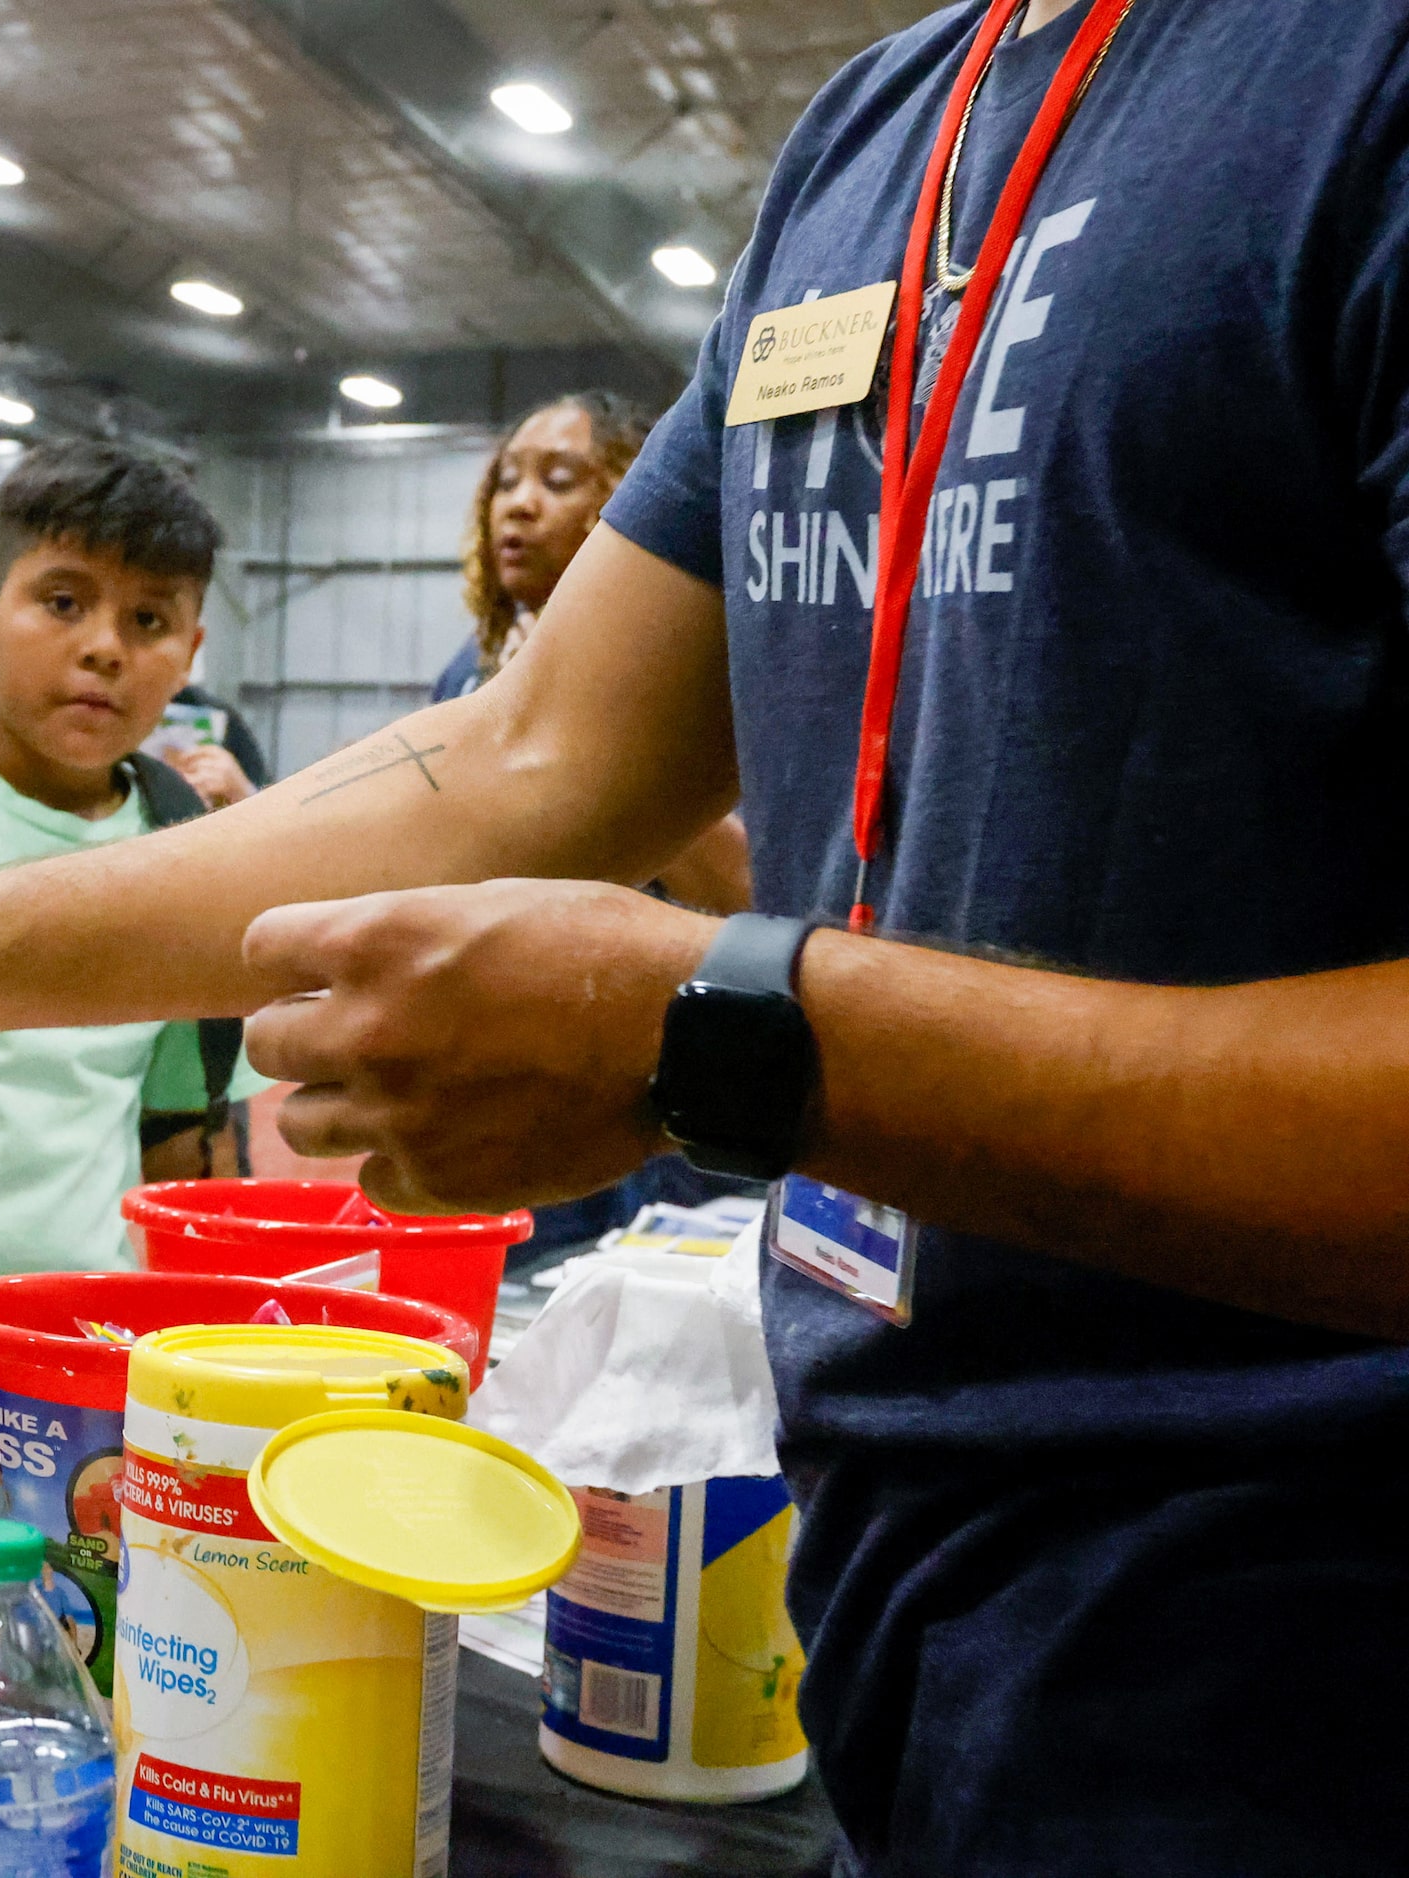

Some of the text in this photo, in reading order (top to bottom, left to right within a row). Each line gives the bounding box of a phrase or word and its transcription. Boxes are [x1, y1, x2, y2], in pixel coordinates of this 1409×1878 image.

[779, 310, 877, 352] BUCKNER
[756, 372, 846, 401] Neako Ramos
[746, 509, 880, 610] SHIN
[45, 1420, 68, 1441] A
[146, 1470, 183, 1496] 99.9%
[154, 1493, 164, 1513] &
[69, 1534, 107, 1552] SAND
[70, 1554, 104, 1571] TURF
[194, 1543, 310, 1575] Lemon Scent
[139, 1763, 160, 1786] Kills
[162, 1773, 196, 1796] Cold
[199, 1782, 210, 1798] &
[213, 1786, 235, 1803] Flu
[144, 1810, 291, 1850] the cause of COVID-19
[146, 1796, 165, 1814] Kills
[254, 1823, 290, 1838] virus,
